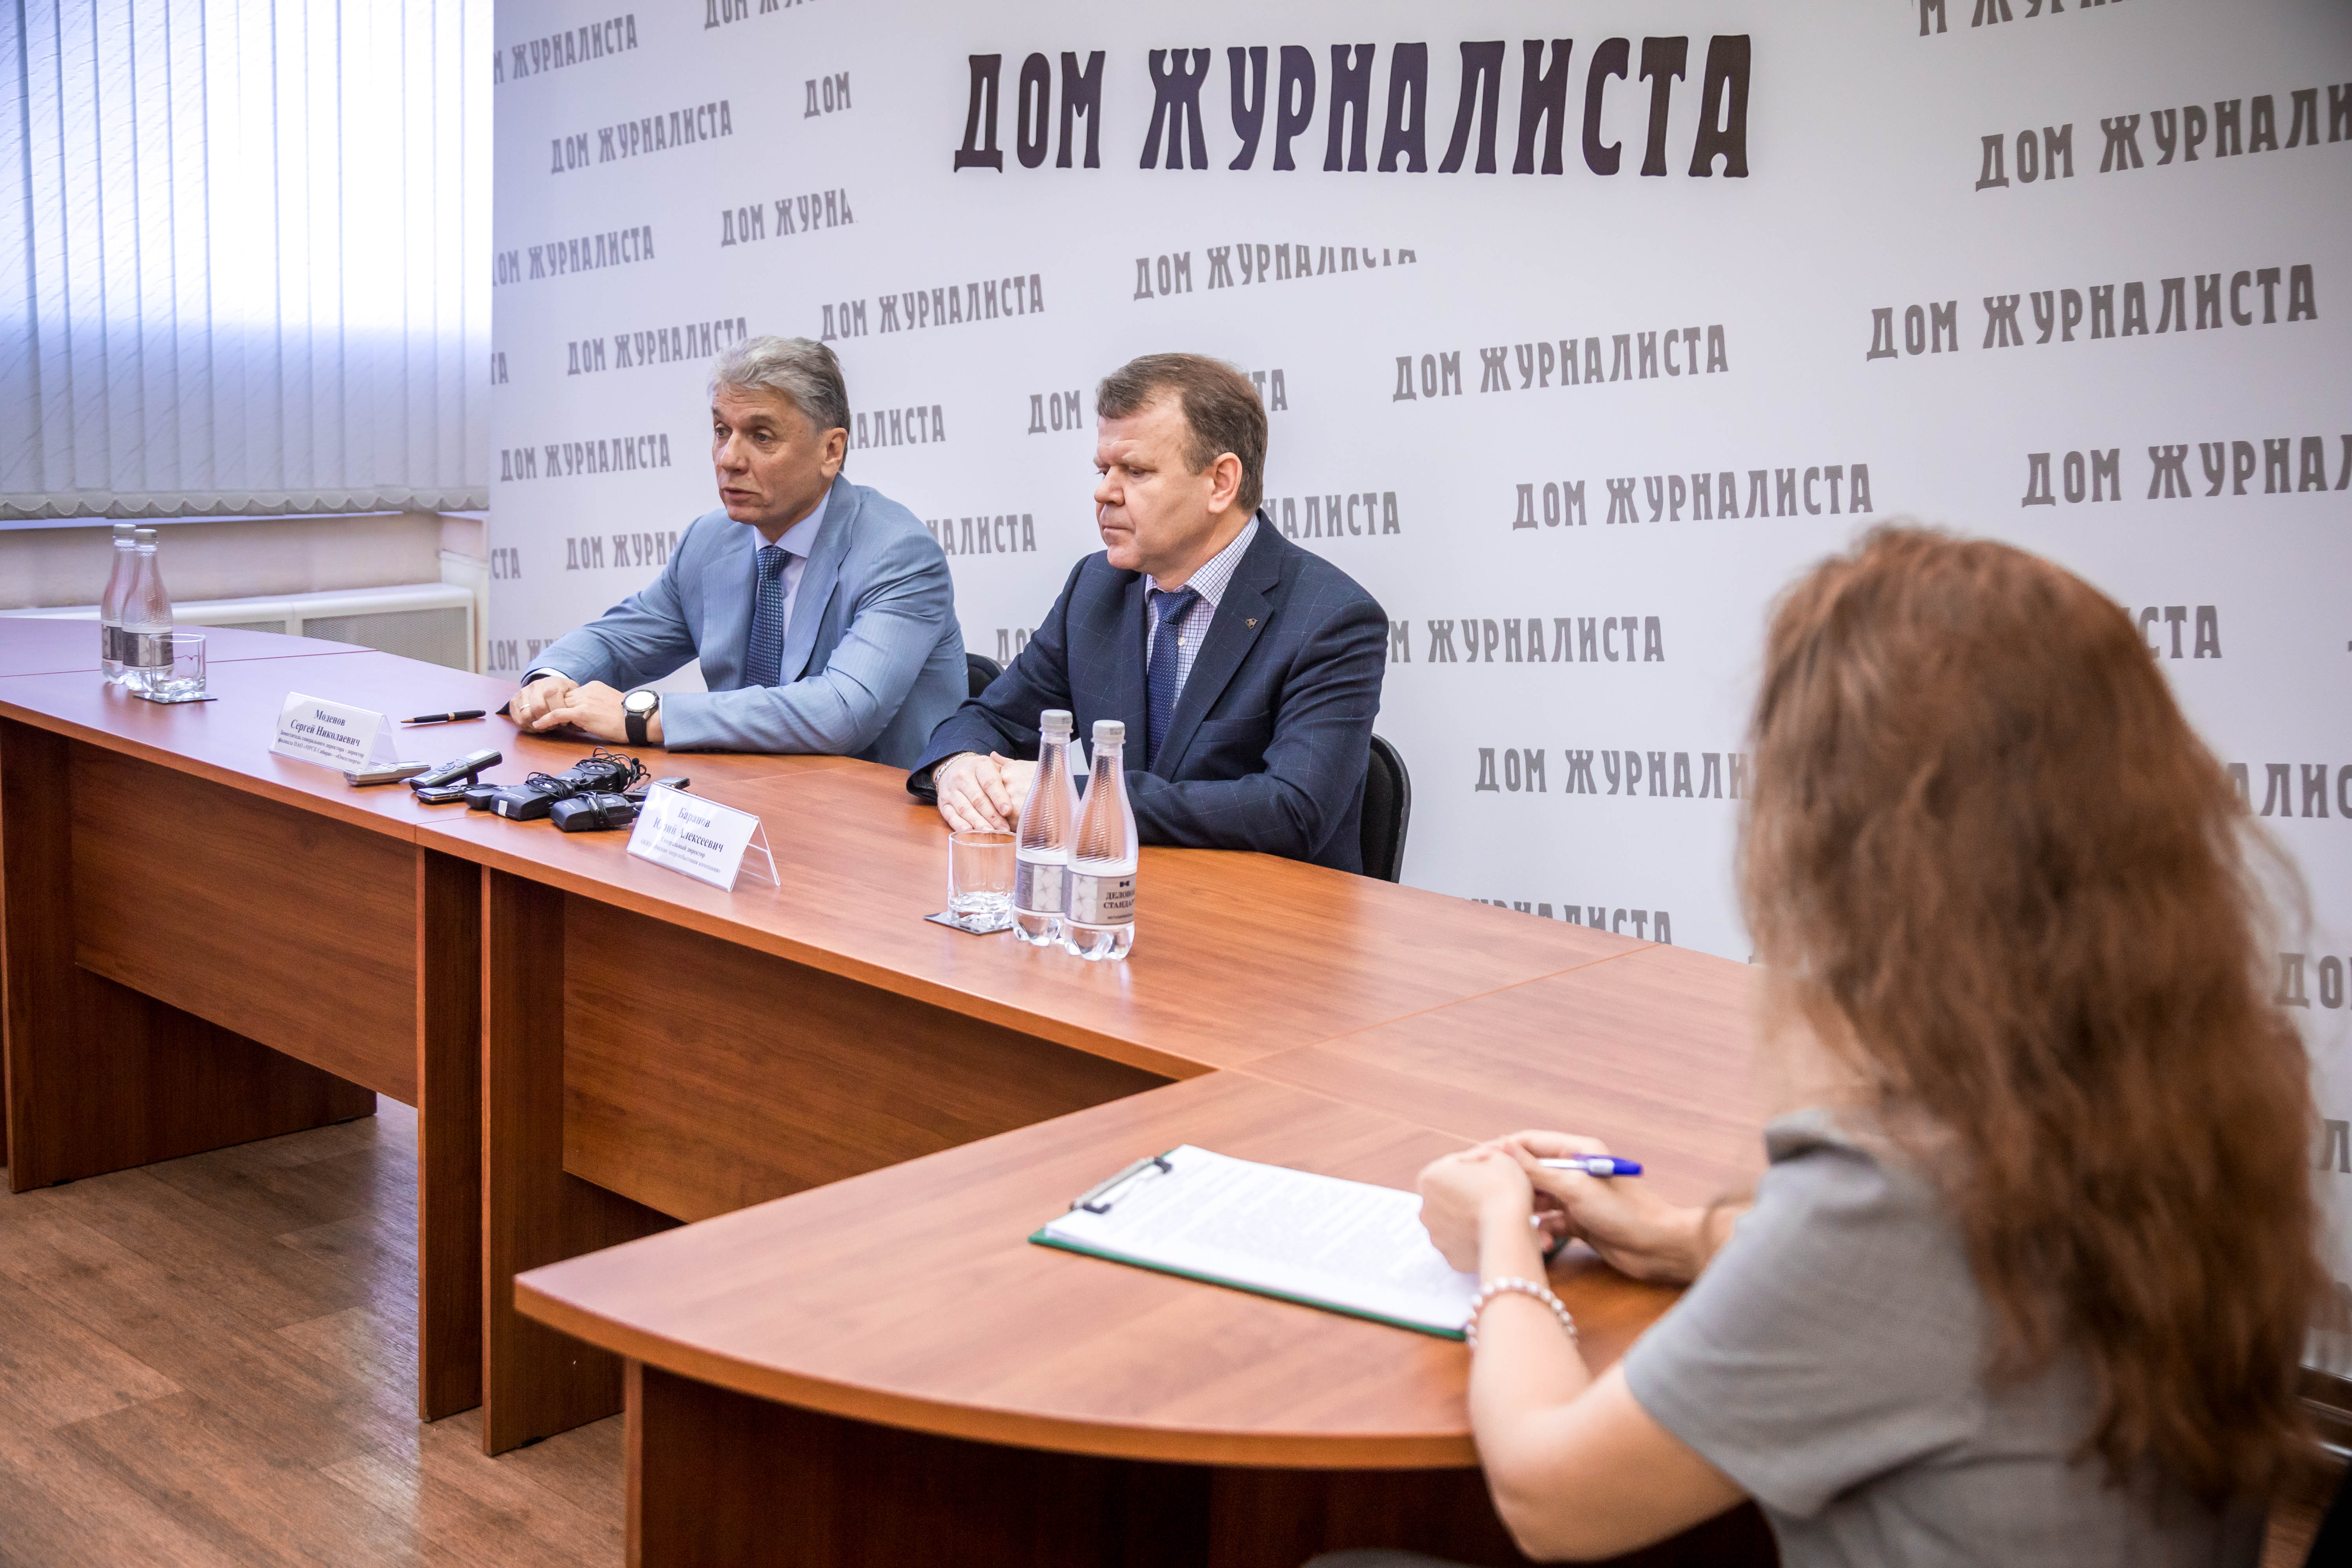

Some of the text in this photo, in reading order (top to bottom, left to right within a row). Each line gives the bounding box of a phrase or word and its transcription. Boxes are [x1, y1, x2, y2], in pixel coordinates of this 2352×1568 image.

[512, 14, 638, 79] ЖУРНАЛИСТА
[804, 72, 851, 119] ДОМ
[954, 34, 1751, 178] ДОМ ЖУРНАЛИСТА
[551, 100, 733, 175] ДОМ ЖУРНАЛИСТА
[1975, 123, 2074, 192] ДОМ
[721, 204, 765, 247] ДОМ
[528, 225, 655, 280] ЖУРНАЛИСТА
[1134, 251, 1193, 301] ДОМ
[820, 274, 1044, 341] ДОМ ЖУРНАЛИСТА
[1867, 264, 2318, 361] ДОМ ЖУРНАЛИСТА
[567, 338, 606, 376] ДОМ
[1393, 324, 1729, 403] ДОМ ЖУРНАЛИСТА
[849, 405, 946, 450] АЛИСТА
[1028, 390, 1082, 435] ДОМ
[501, 434, 671, 482] ДОМ ЖУРНАЛИСТА
[2022, 448, 2122, 508] ДОМ
[1262, 491, 1401, 539] НАЛИСТА
[1513, 464, 1873, 531] ДОМ ЖУРНАЛИСТА
[566, 536, 604, 571] ДОМ
[926, 514, 1037, 555] НАЛИСТА
[996, 628, 1035, 665] ДО
[1428, 616, 1665, 662] ЖУРНАЛИСТА
[290, 719, 361, 747] Сергей Николаевич
[314, 710, 346, 726] Моденов
[1475, 747, 1750, 799] ДОМ ЖУРНАЛИ
[678, 808, 710, 828] Баранов
